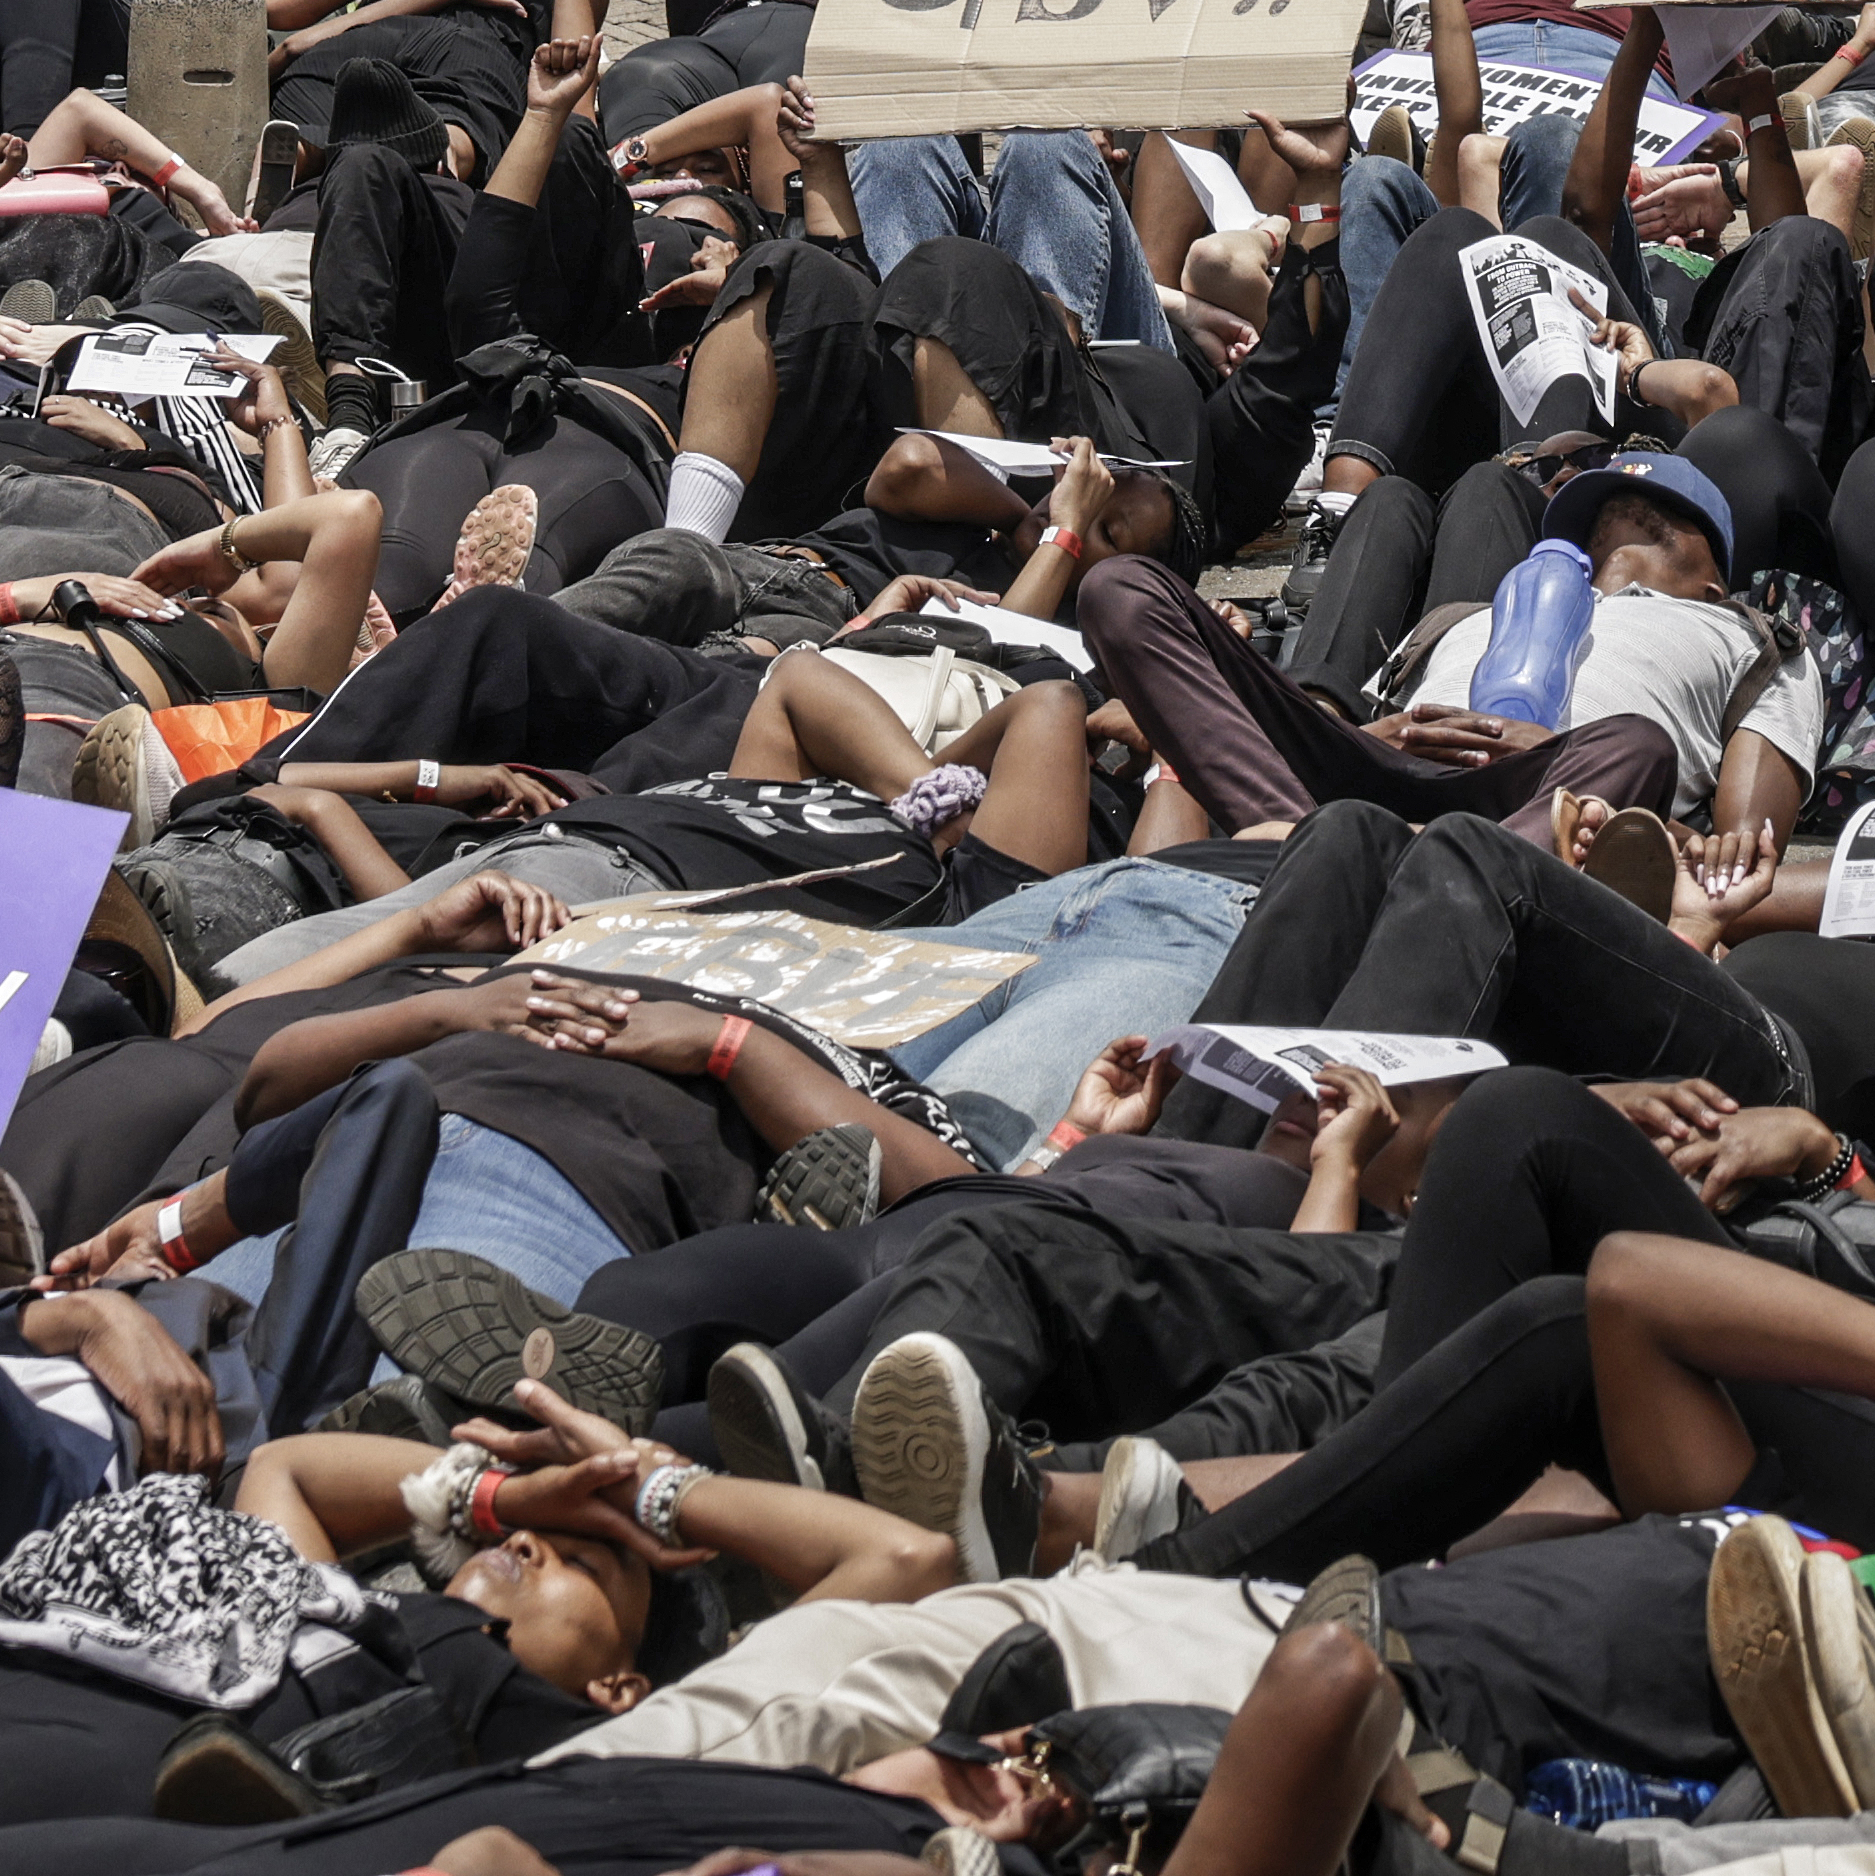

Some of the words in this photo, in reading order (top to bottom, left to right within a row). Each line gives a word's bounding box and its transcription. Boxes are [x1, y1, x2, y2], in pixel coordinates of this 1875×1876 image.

[1480, 65, 1599, 102] OMEN'
[1487, 267, 1505, 282] FROM
[1505, 263, 1537, 275] OUTRAGE
[1506, 269, 1530, 281] POWER
